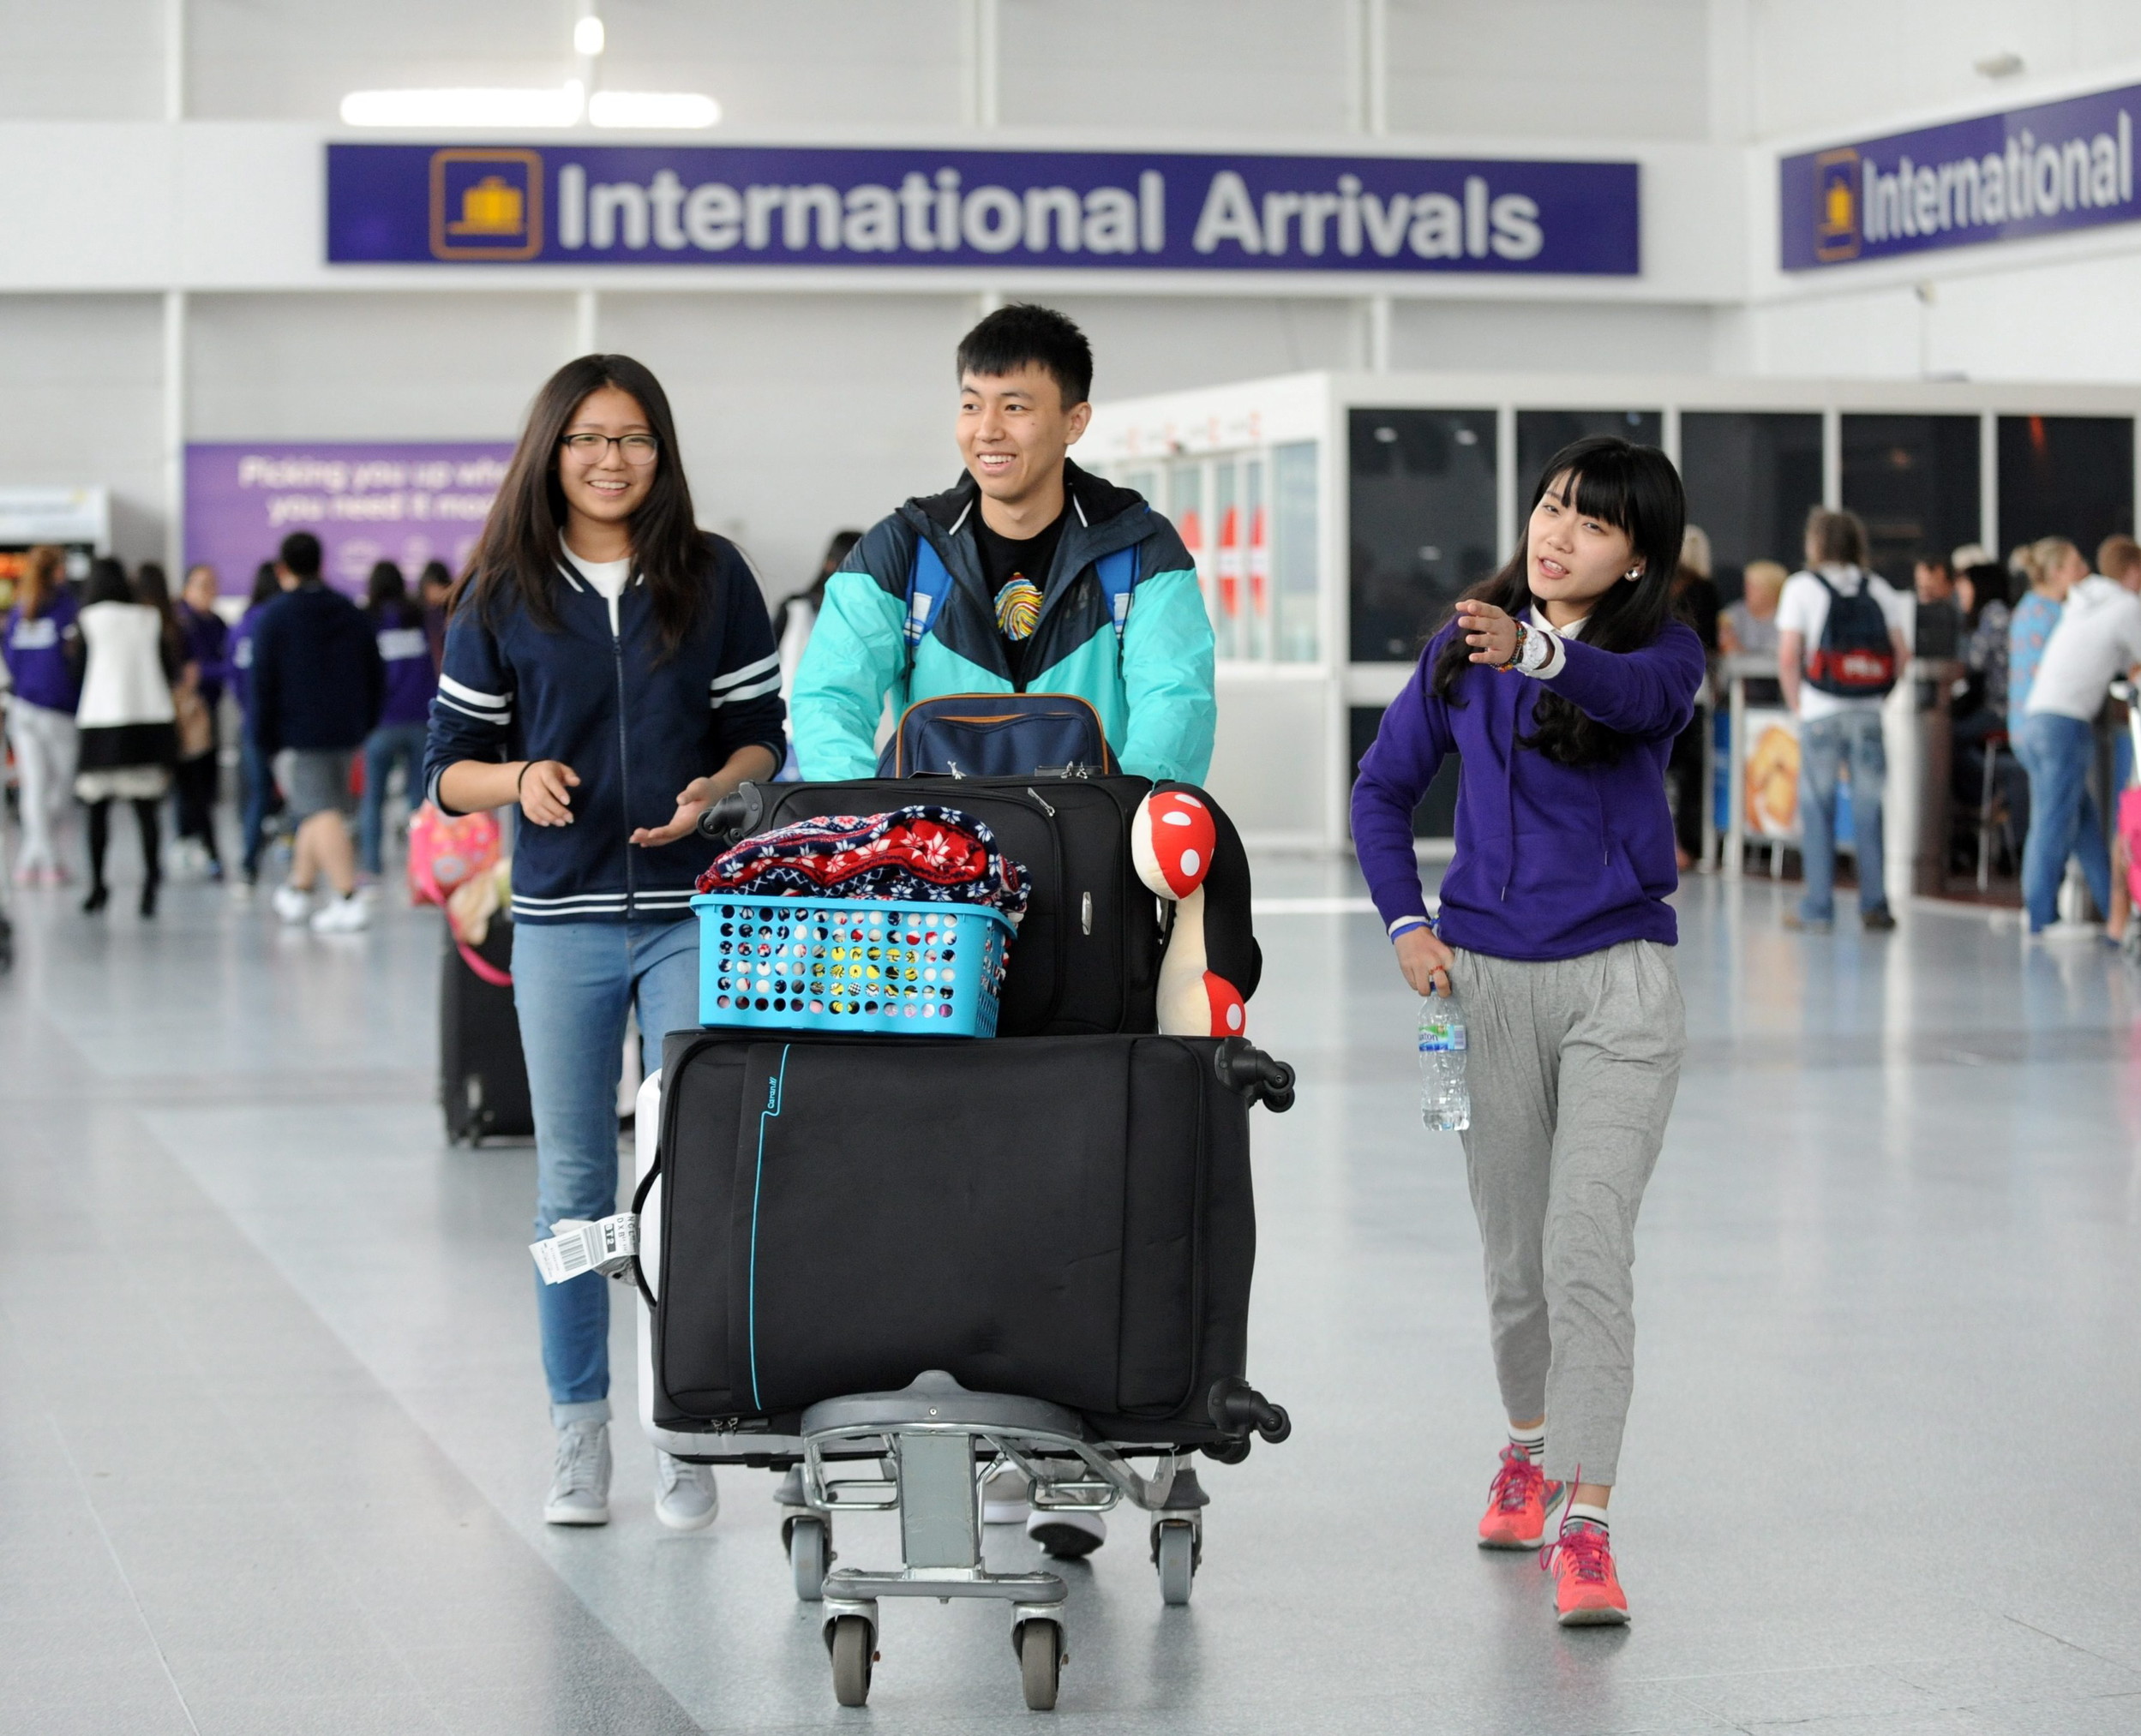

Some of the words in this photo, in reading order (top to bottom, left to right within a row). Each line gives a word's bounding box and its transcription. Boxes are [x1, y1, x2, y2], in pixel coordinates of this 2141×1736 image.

[1862, 108, 2133, 242] International
[558, 164, 1165, 254] International
[1192, 171, 1544, 260] Arrivals
[238, 455, 347, 493] Picking
[352, 461, 405, 493] you
[267, 493, 324, 527] you
[331, 491, 405, 521] need
